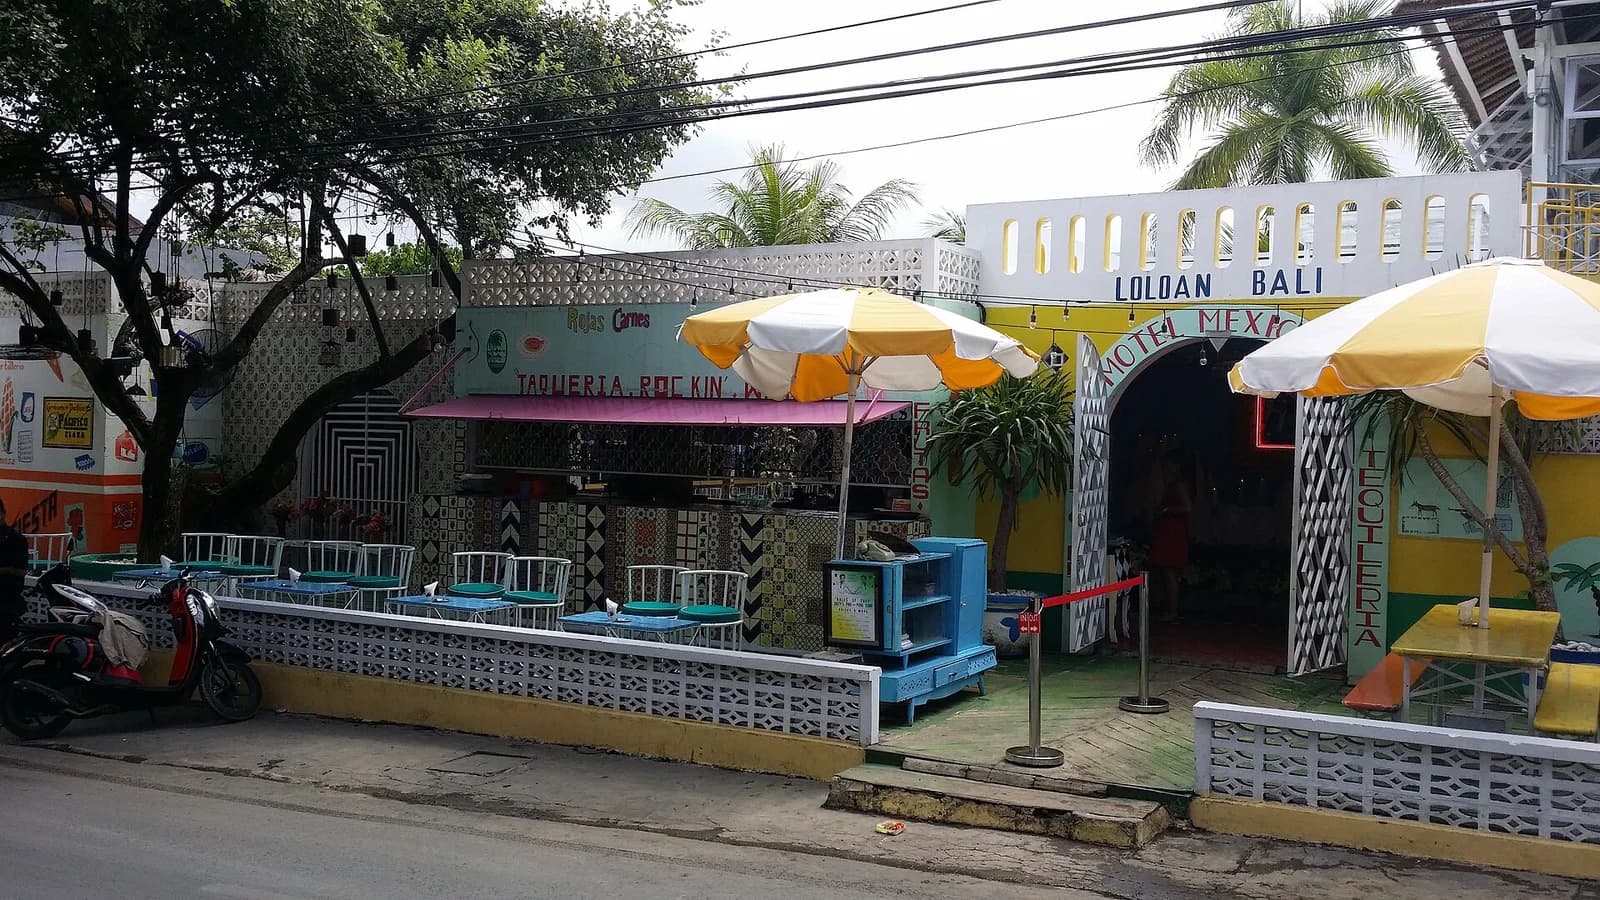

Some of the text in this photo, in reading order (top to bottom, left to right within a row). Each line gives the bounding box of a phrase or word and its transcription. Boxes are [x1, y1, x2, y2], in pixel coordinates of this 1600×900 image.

[1115, 267, 1323, 301] LOLOAN BALI
[567, 307, 650, 334] Rojas Carnes
[1102, 308, 1297, 387] MOTEL MEXIC
[1354, 450, 1386, 648] TEQUILERIA
